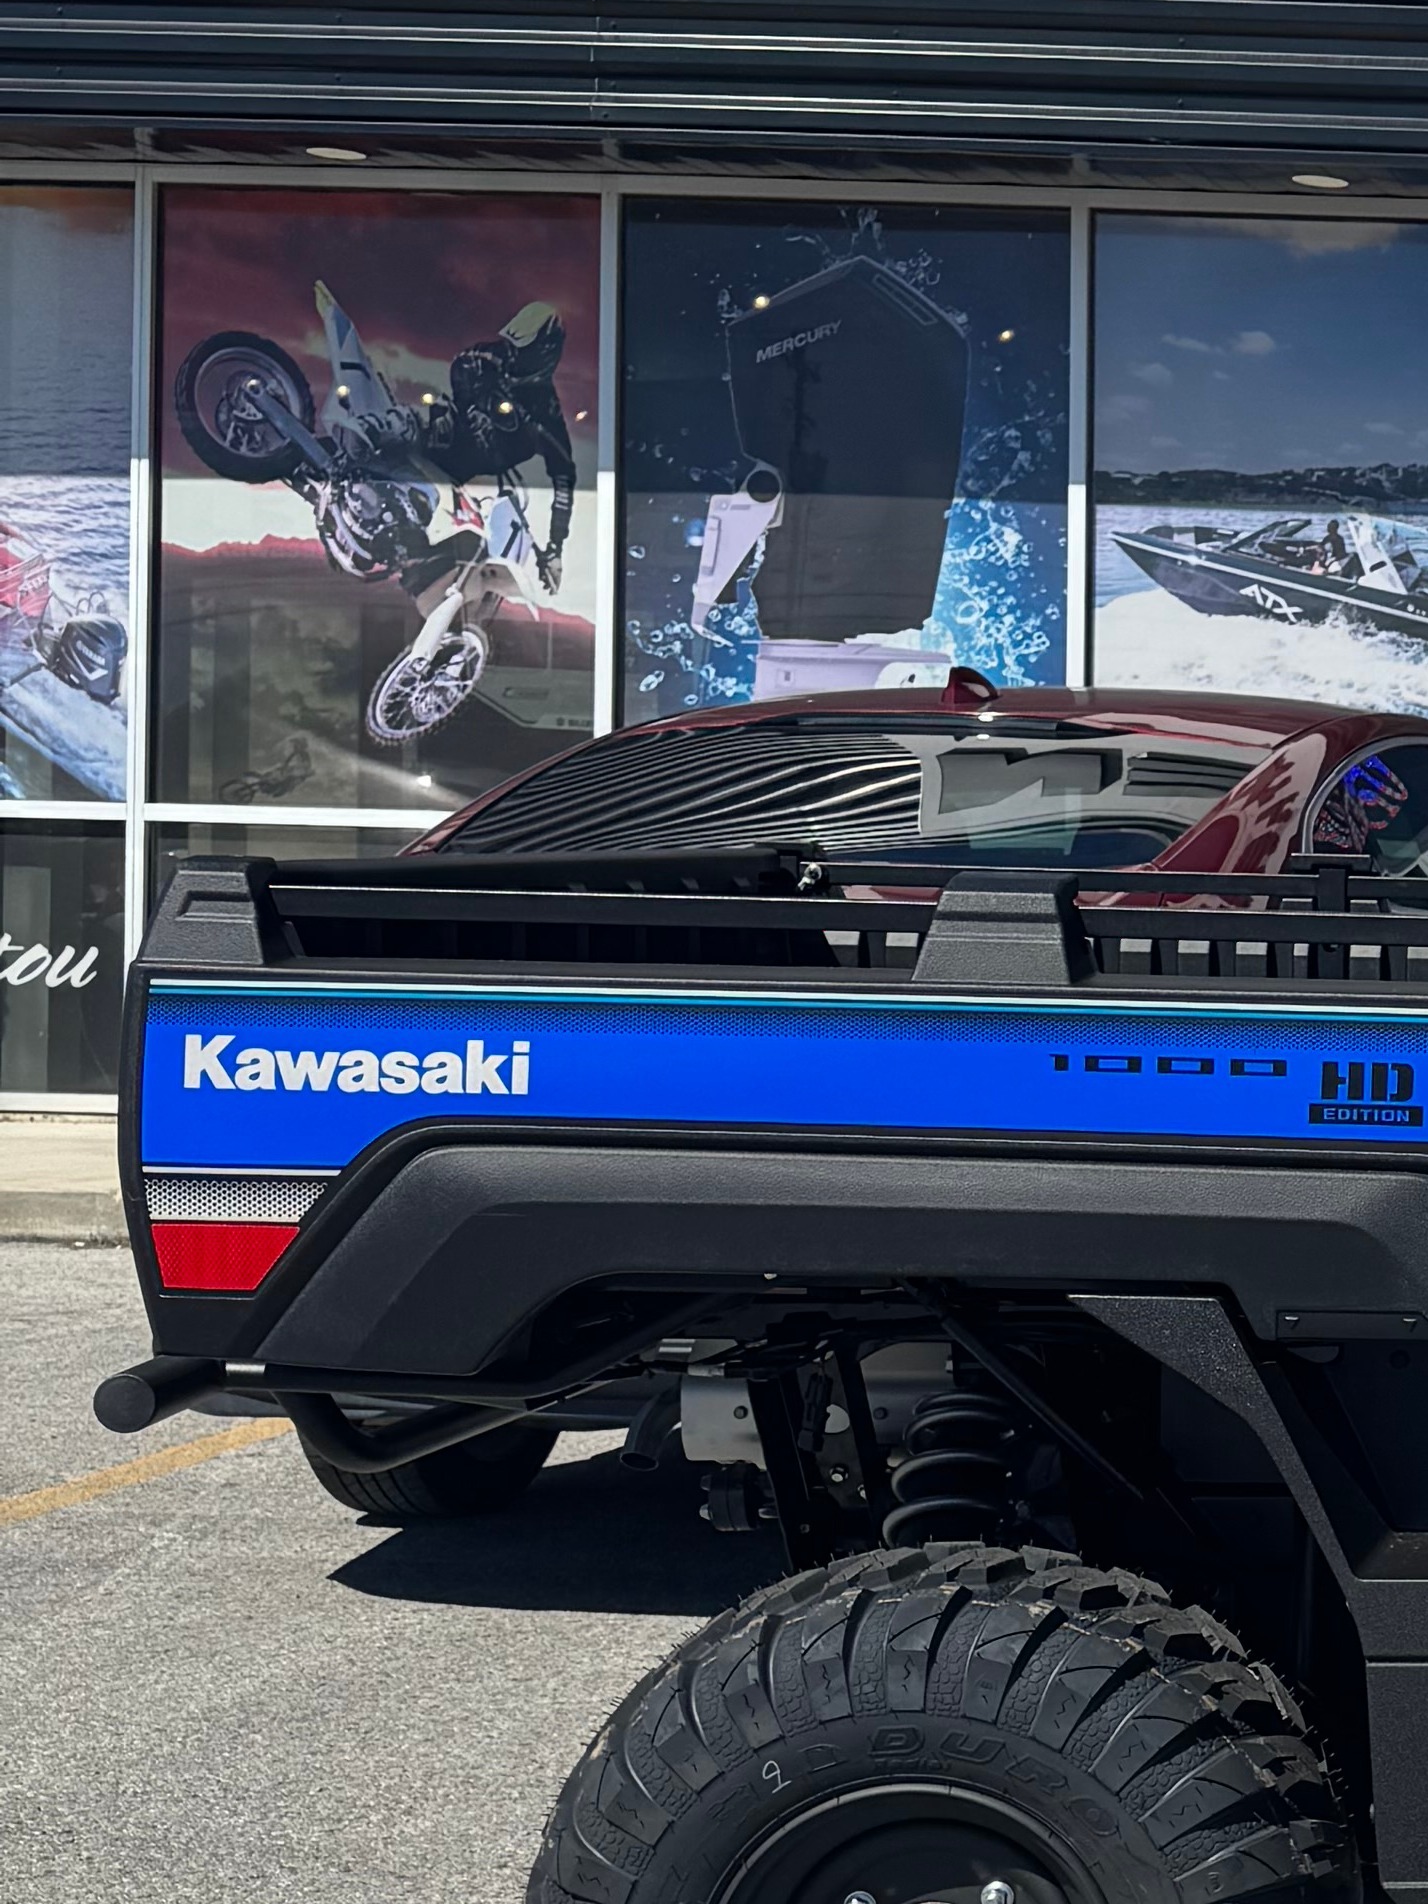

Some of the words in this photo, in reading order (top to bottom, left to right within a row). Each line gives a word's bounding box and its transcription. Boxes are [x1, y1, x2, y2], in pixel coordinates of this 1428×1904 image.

[756, 320, 842, 364] MERCURY
[1239, 583, 1303, 624] ATX
[183, 1034, 530, 1095] Kawasaki
[1050, 1053, 1287, 1077] 1000
[1320, 1061, 1414, 1102] HD
[1322, 1107, 1410, 1123] EDITION
[867, 1724, 1119, 1837] DURO
